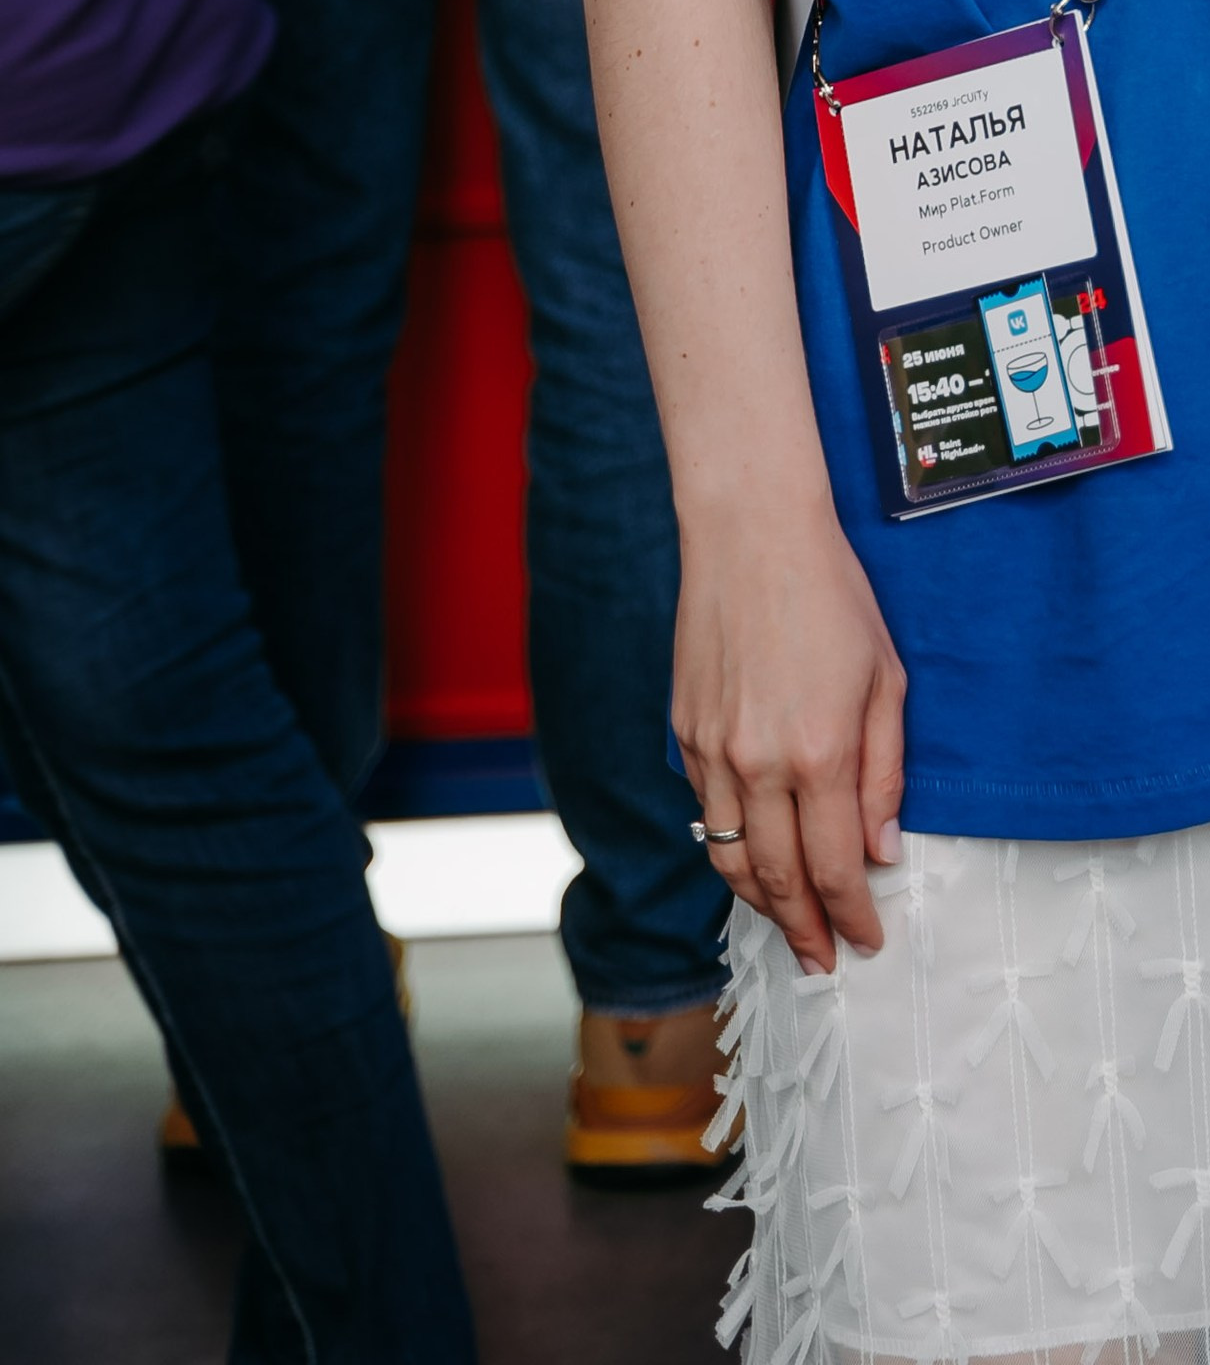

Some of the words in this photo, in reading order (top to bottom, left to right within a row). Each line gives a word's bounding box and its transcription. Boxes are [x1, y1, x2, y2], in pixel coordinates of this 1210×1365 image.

[910, 99, 949, 118] 5522169
[888, 104, 1026, 164] НАТАЛЬЯ
[917, 150, 1012, 190] АЗИСОВА
[918, 203, 948, 219] Мир
[950, 186, 1015, 211] Plat.Form
[922, 230, 977, 255] Product
[979, 220, 1023, 240] Owner
[1077, 288, 1108, 314] 24
[902, 350, 923, 369] 25
[924, 343, 965, 364] июня
[907, 373, 965, 405] 15:40
[974, 396, 995, 409] врем
[941, 416, 951, 424] на
